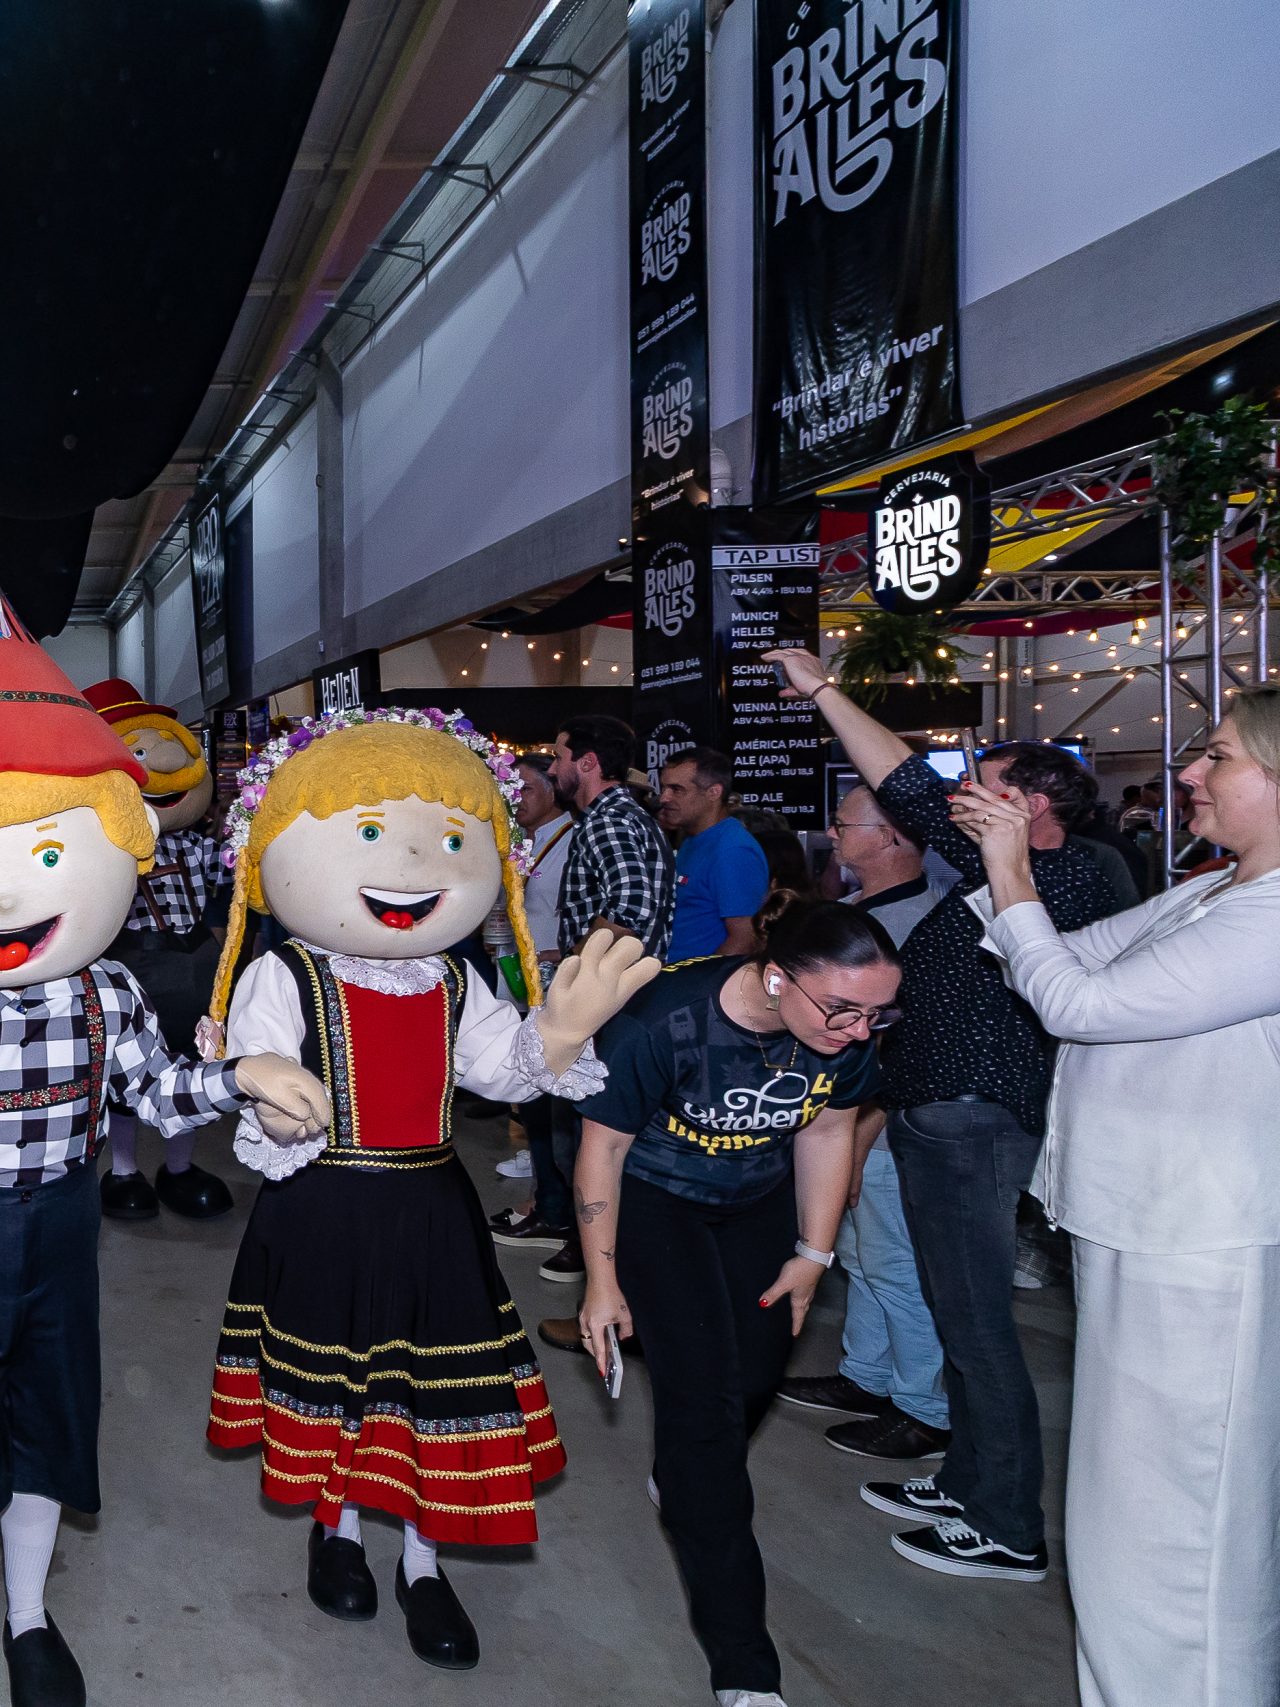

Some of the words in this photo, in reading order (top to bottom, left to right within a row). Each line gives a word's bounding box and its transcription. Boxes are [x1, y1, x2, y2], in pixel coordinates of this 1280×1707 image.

[641, 8, 690, 80] BRIND
[641, 32, 690, 112] ALLES
[773, 9, 946, 227] ALLES
[642, 192, 691, 254] BRIND
[642, 217, 691, 286] ALLES
[879, 324, 944, 368] viver
[643, 376, 693, 425] BRIND
[643, 401, 693, 459] ALLES
[883, 471, 951, 505] CERVEJARIA
[875, 494, 961, 549] BRIND
[724, 549, 769, 564] TAP
[776, 548, 820, 563] LIST
[875, 528, 961, 601] ALLES
[644, 559, 696, 598] BRIND
[730, 573, 773, 583] PILSEN
[730, 588, 750, 596] ABV
[644, 584, 696, 637] ALLES
[731, 611, 779, 621] MUNICH
[731, 627, 775, 637] HELLES
[731, 641, 750, 649] ABV
[732, 664, 774, 675] SCHWA
[732, 679, 752, 687] ABV
[733, 702, 777, 712] VIENNA
[779, 700, 817, 711] LAGER
[733, 717, 753, 725] ABV
[733, 738, 787, 751] AMÉRICA
[788, 738, 818, 749] PALE
[734, 756, 756, 766] ALE
[759, 754, 790, 766] (APA)
[734, 770, 753, 778] ABV
[743, 793, 759, 803] ED
[761, 792, 784, 802] ALE
